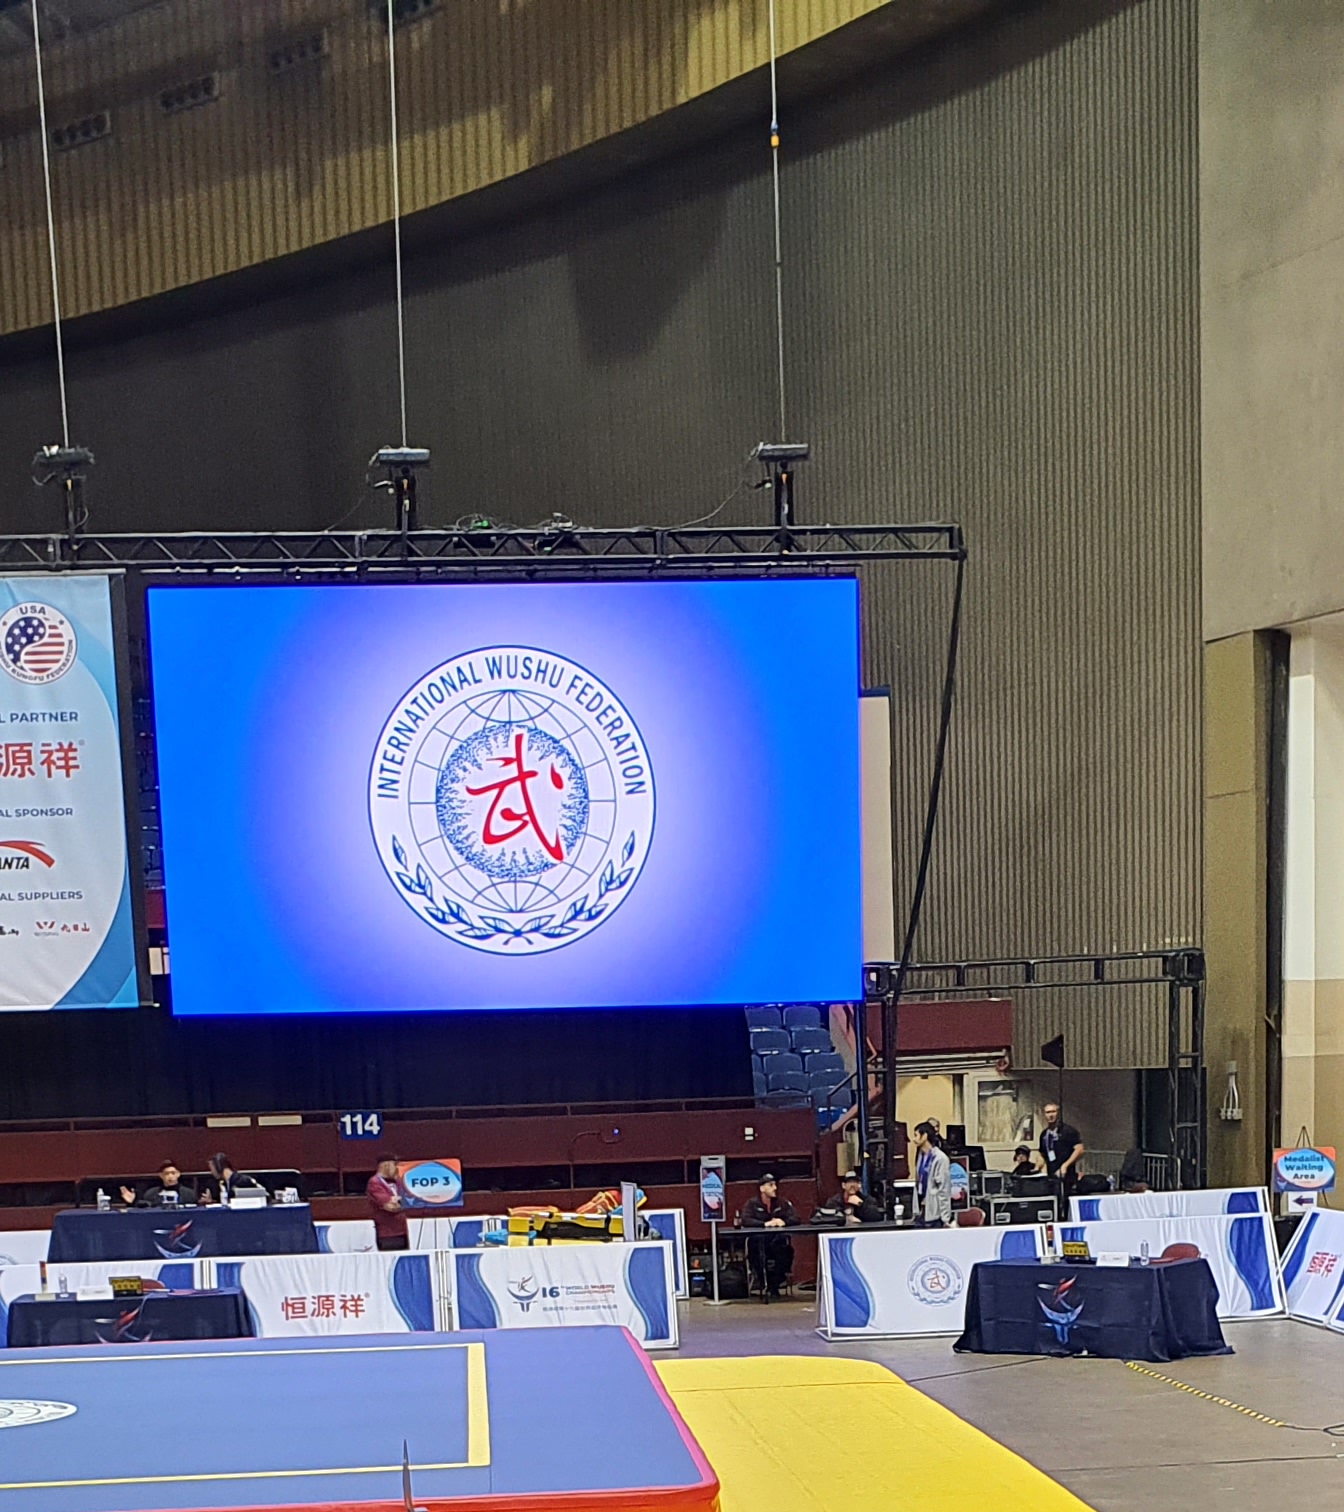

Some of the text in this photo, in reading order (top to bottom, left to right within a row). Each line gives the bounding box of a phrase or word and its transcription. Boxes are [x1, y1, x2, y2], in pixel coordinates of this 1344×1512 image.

[19, 605, 47, 615] USA
[10, 667, 45, 682] KUNGFU
[9, 711, 79, 724] PARTNER
[377, 654, 647, 800] INTERNATIONAL WUSHU FEDERATION
[464, 732, 565, 862] 武
[14, 807, 74, 818] SPONSOR
[17, 890, 84, 902] SUPPLIERS
[340, 1113, 381, 1136] 114
[1283, 1154, 1325, 1163] Medalist
[1284, 1163, 1324, 1173] Waiting
[411, 1176, 451, 1188] FOP 3
[541, 1286, 560, 1299] 16
[281, 1293, 366, 1321] 恒源祥
